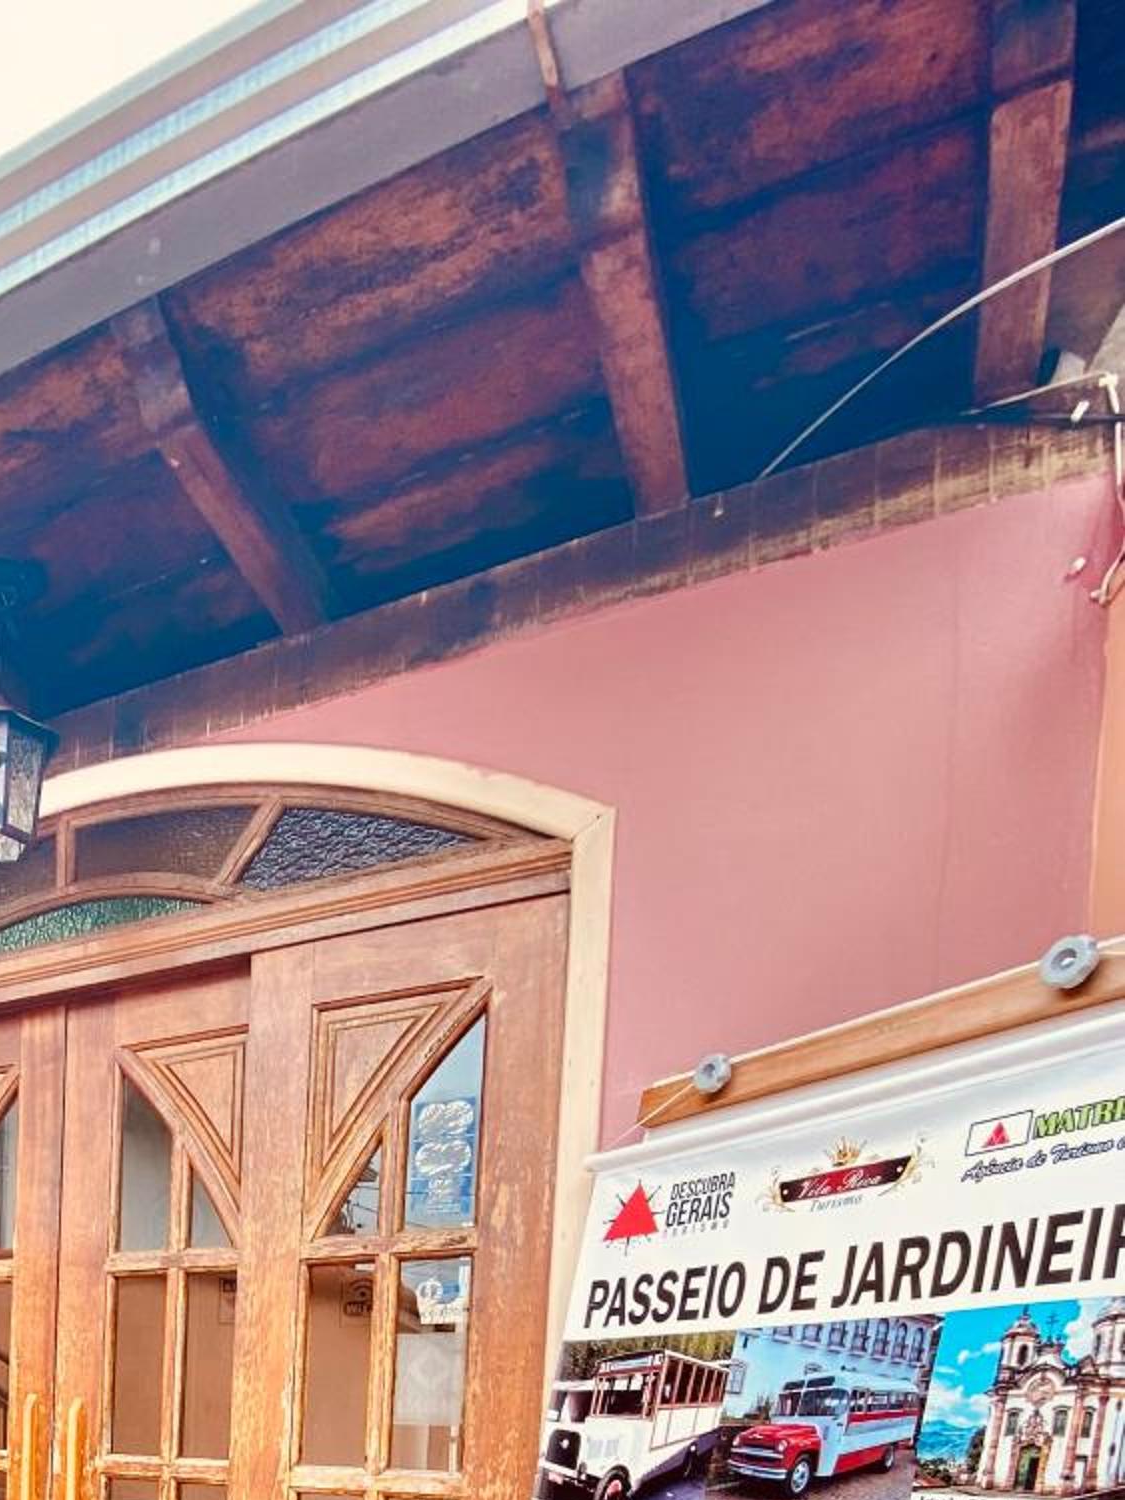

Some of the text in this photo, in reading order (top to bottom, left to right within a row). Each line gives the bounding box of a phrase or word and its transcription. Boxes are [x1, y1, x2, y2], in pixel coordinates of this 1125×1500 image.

[960, 1158, 1023, 1184] Agência
[1026, 1149, 1047, 1169] de
[1050, 1139, 1114, 1165] Turismo
[670, 1171, 736, 1200] DESCUBRA
[666, 1191, 734, 1228] GERAIS
[583, 1261, 747, 1329] PASSEIO
[758, 1249, 825, 1315] DE
